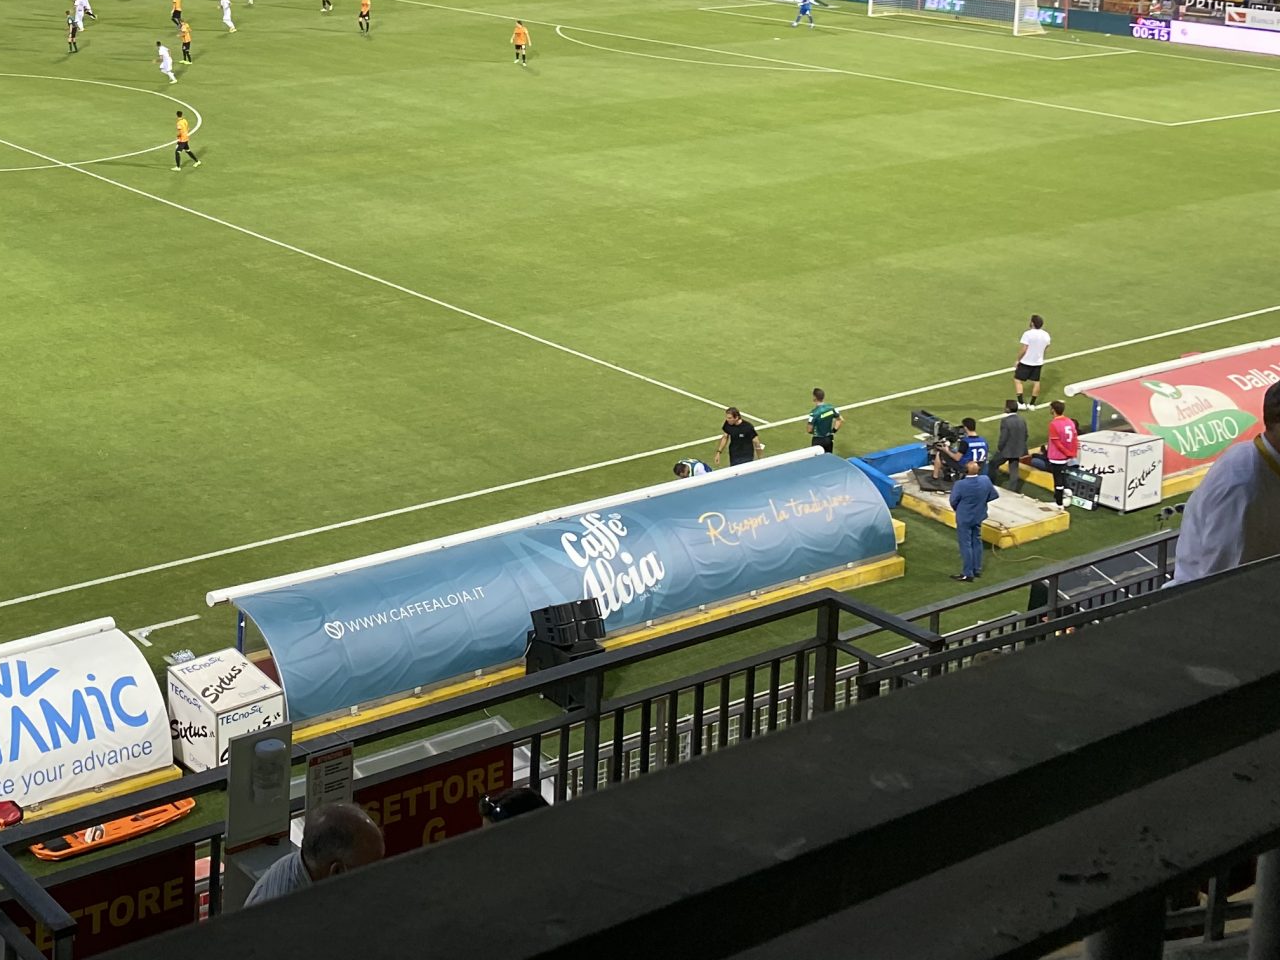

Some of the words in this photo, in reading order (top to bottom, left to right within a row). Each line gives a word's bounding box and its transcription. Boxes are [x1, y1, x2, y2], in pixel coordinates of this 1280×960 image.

[1132, 26, 1169, 41] 00:15
[1226, 368, 1280, 392] Dalla
[1064, 425, 1073, 442] 5
[1172, 416, 1239, 456] MAURO
[971, 448, 987, 462] 12
[698, 511, 770, 547] Riscopri
[768, 498, 790, 523] la
[583, 550, 666, 620] Aloia
[344, 586, 486, 633] WWW.CAFFEALOIA.IT
[20, 762, 66, 795] your
[71, 739, 153, 776] advance
